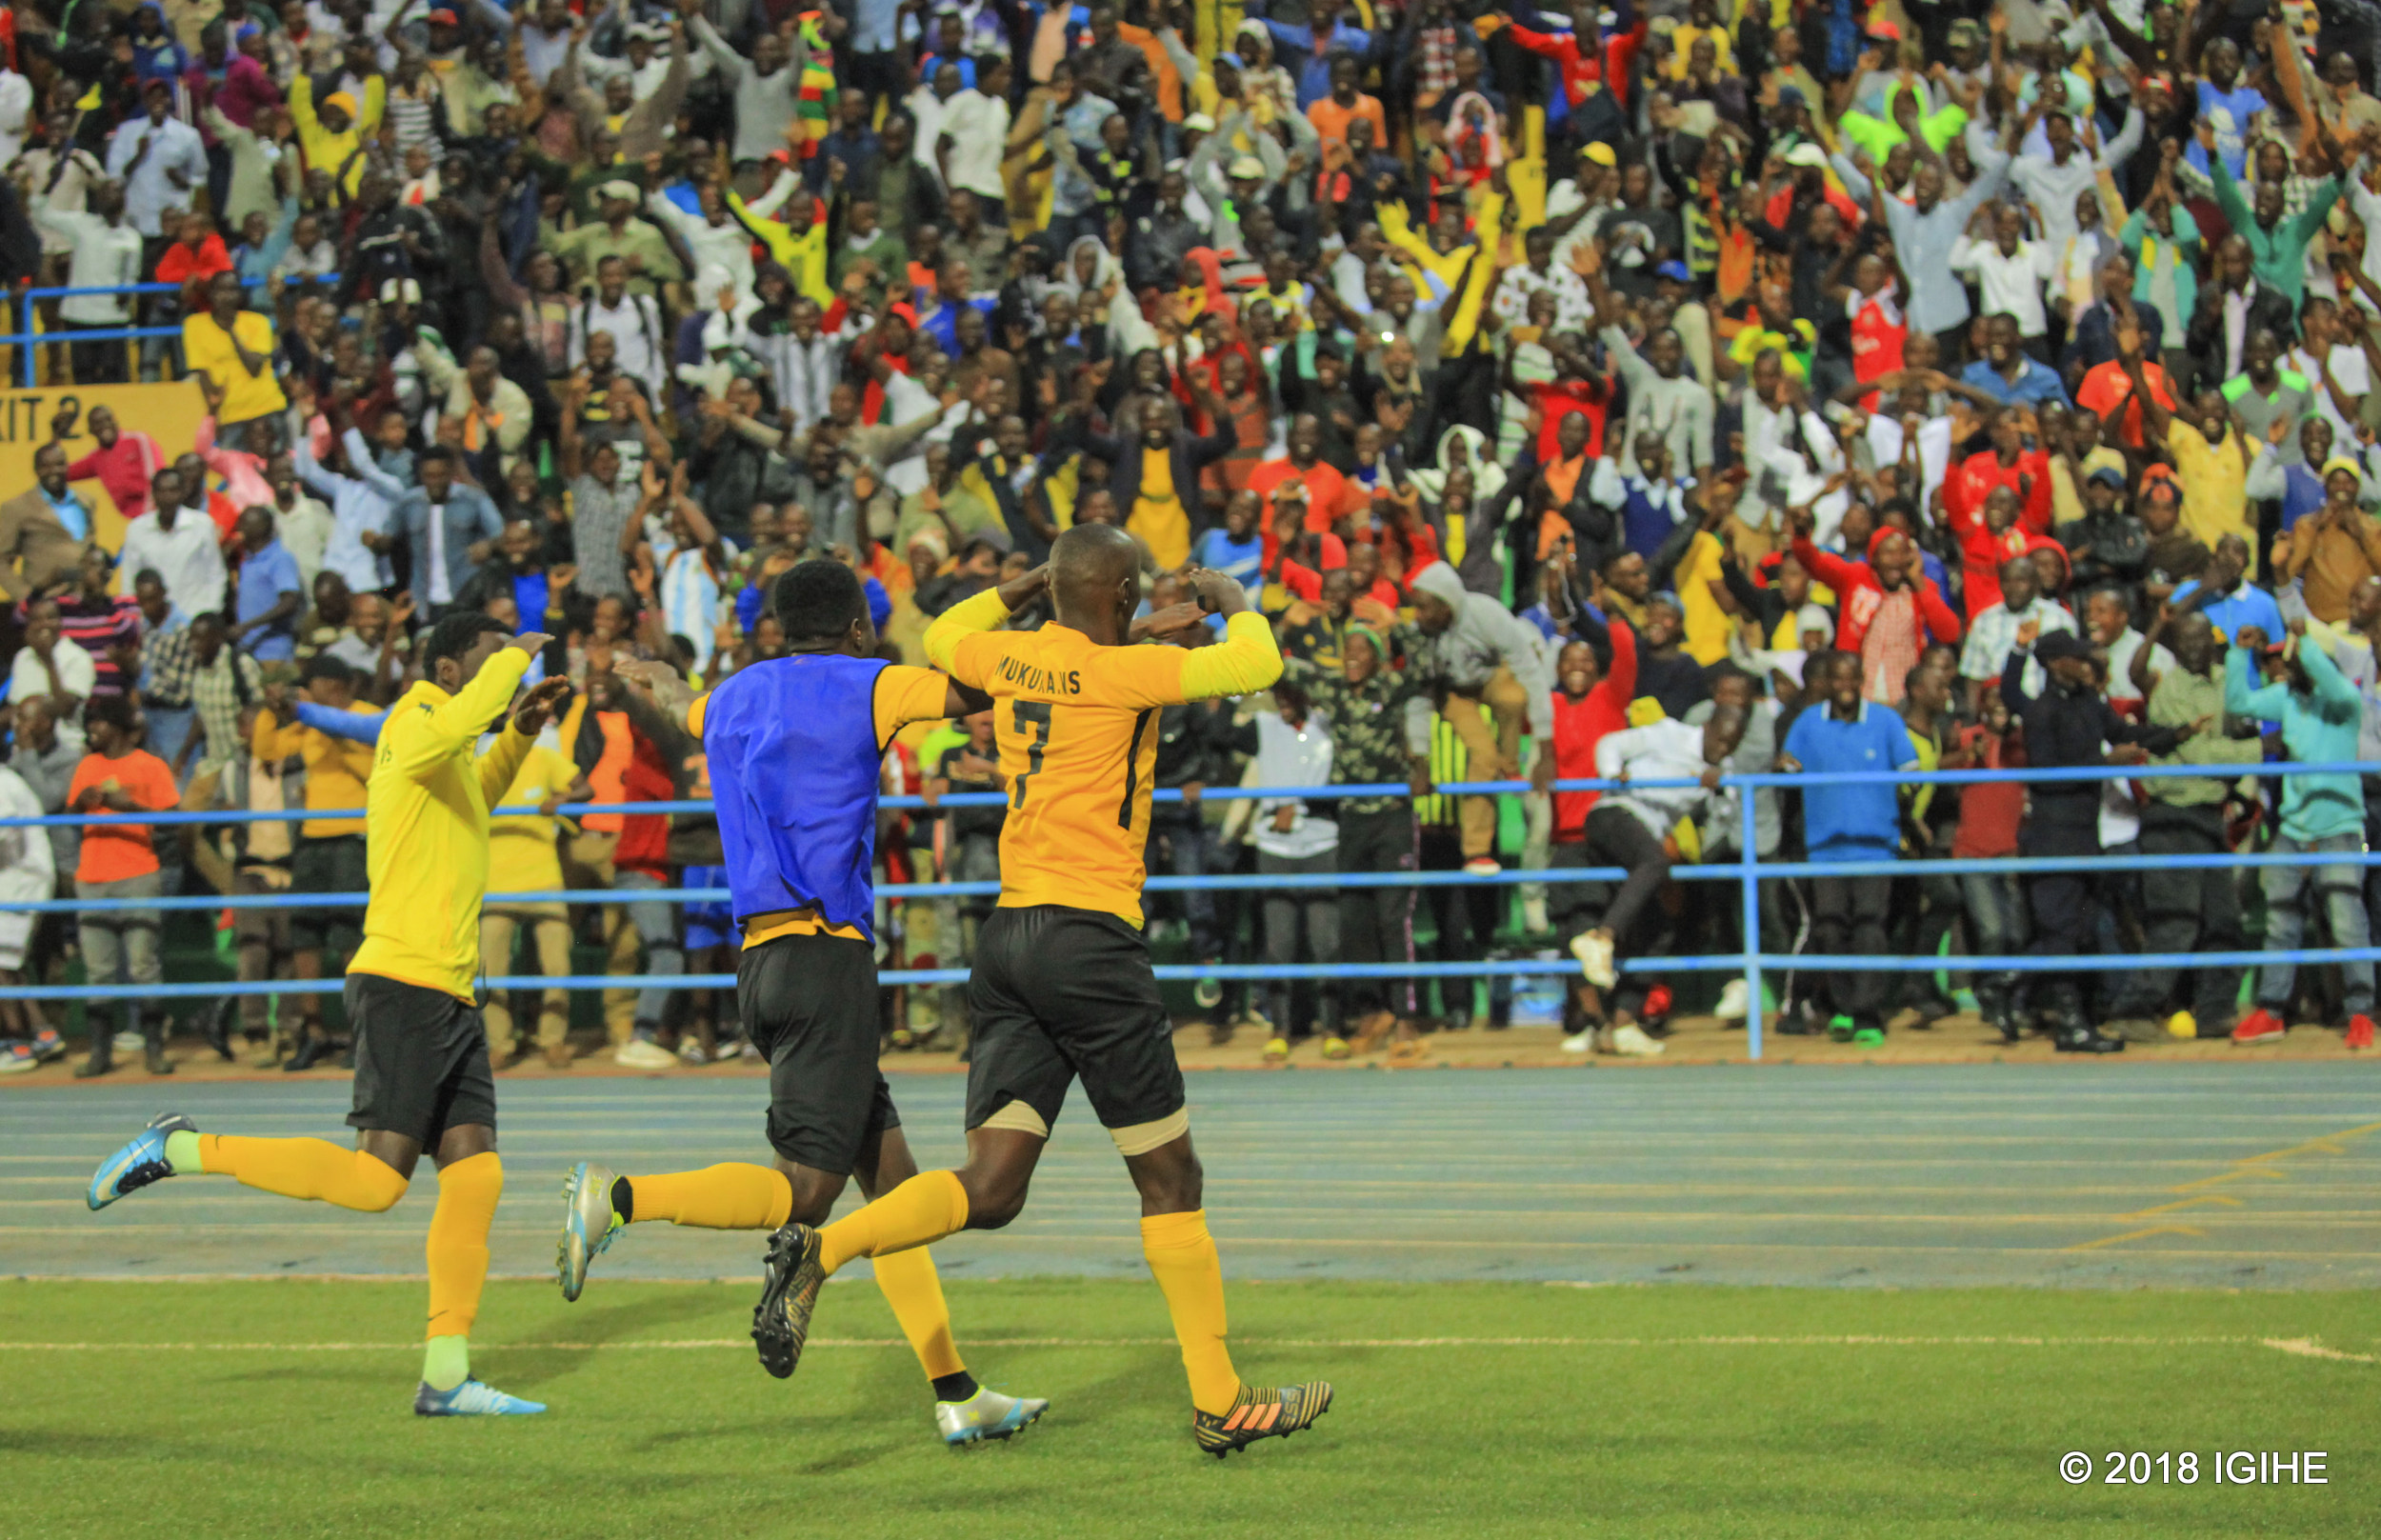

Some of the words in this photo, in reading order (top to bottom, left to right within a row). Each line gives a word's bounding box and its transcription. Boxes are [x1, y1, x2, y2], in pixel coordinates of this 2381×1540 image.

[0, 396, 43, 442] IT
[59, 395, 82, 440] 2
[1012, 698, 1053, 810] 7
